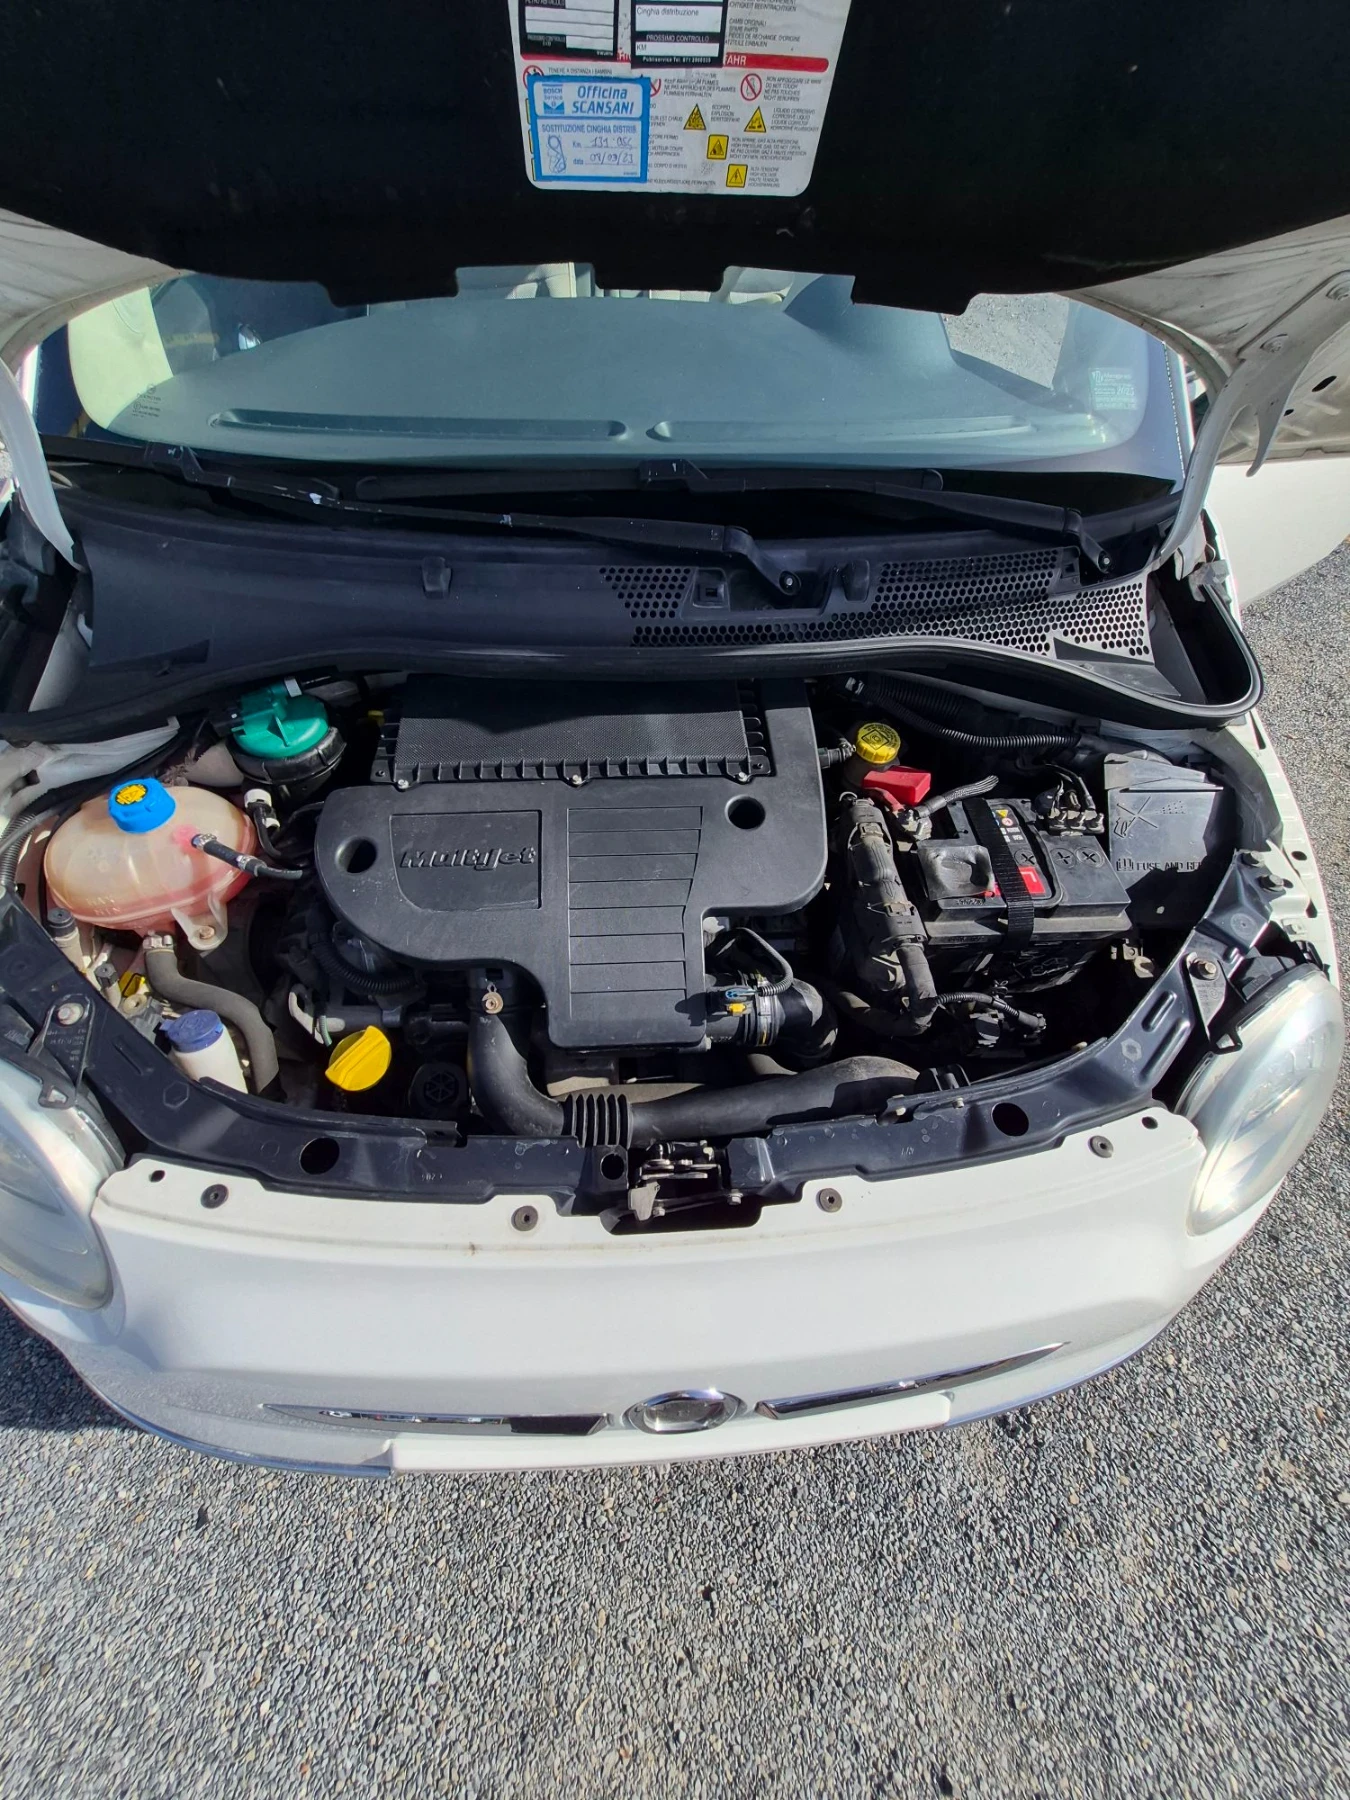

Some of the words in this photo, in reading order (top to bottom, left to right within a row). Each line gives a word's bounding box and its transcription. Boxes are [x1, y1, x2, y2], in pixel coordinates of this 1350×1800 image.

[636, 8, 659, 17] Cinghia
[662, 8, 699, 16] distribuzione
[577, 86, 628, 99] Officina
[572, 101, 634, 115] SCANSANI
[541, 124, 585, 133] SOSTITUZIONE
[586, 125, 611, 133] CINGHIA
[1164, 862, 1184, 870] AND
